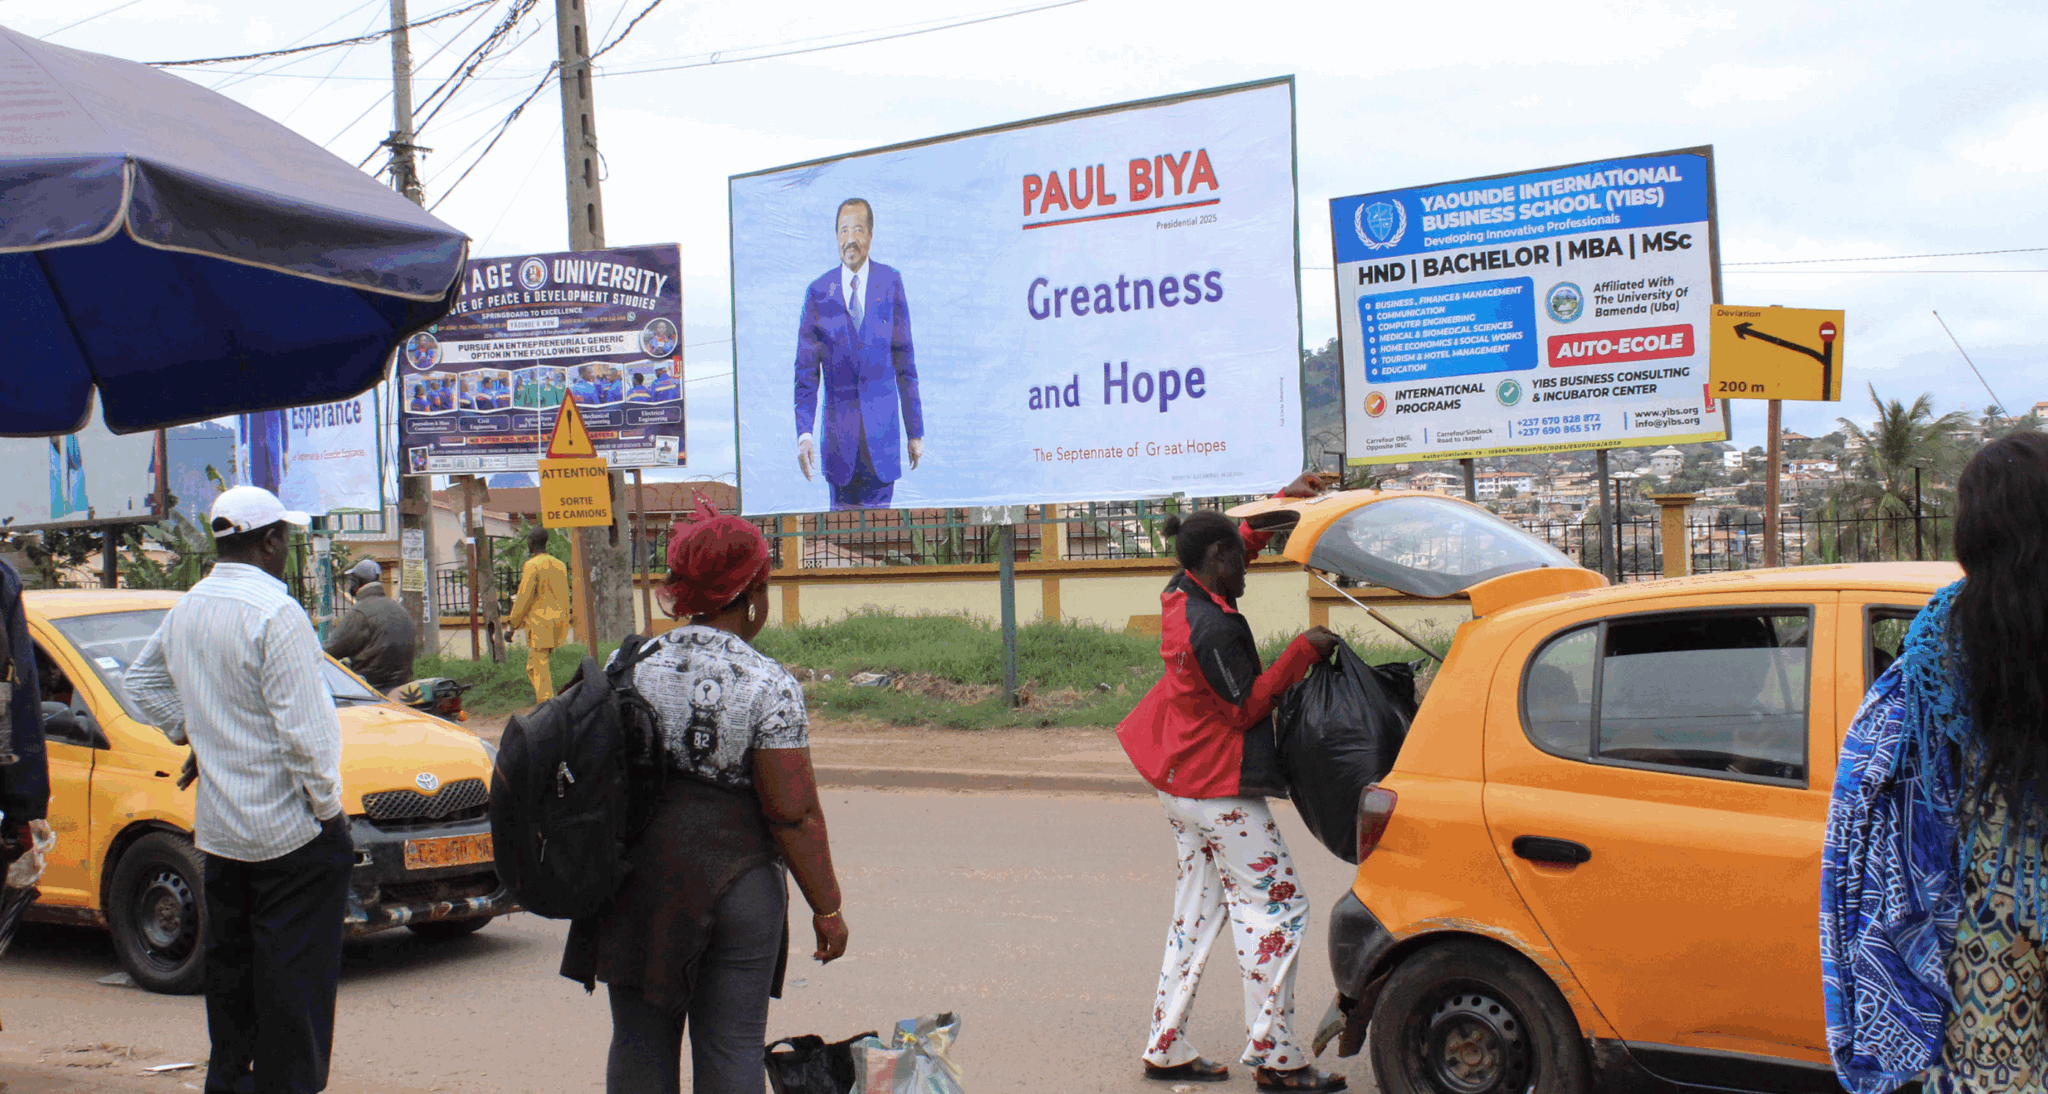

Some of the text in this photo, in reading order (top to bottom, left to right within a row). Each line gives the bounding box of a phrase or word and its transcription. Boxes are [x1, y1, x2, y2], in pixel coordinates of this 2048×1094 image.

[1022, 148, 1219, 217] PAUL BIYA
[1420, 165, 1682, 213] YAOUNDE INTERNATIONAL
[1422, 186, 1665, 232] BUSINESS SCHOOL (YIBS)
[1156, 214, 1218, 230] Presidential 2025
[1423, 212, 1621, 248] Developing Innovative Professionals
[1358, 262, 1406, 286] HND
[1423, 244, 1549, 277] BACHELOR
[1568, 235, 1624, 261] MBA
[1642, 230, 1693, 254] MSc
[461, 259, 668, 298] AGE UNIVERSITY
[1592, 275, 1674, 293] Affiliated With
[471, 298, 484, 311] OF
[487, 292, 520, 308] PEACE
[524, 292, 531, 303] &
[534, 289, 609, 303] DEVELOPMENT
[612, 293, 656, 311] STUDIES
[1027, 270, 1224, 321] Greatness
[1462, 285, 1523, 300] MANAGEMENT
[1594, 286, 1689, 306] The University Of
[481, 306, 583, 320] SPRINGBOARD TO EXCELLENCE
[1376, 306, 1446, 321] COMMUNICATION
[1595, 300, 1680, 318] Bamenda (Uba)
[1378, 313, 1476, 331] COMPUTER ENGINEERING
[1379, 331, 1413, 343] MEDICAL
[1422, 325, 1471, 338] BIOMEDICAL
[1473, 321, 1513, 333] SCIENCES
[458, 335, 625, 352] PURSUE AN ENTREPRENEURIAL GENERIC
[1380, 343, 1403, 354] HOME
[1404, 338, 1452, 351] ECONOMICS
[1459, 333, 1490, 345] SOCIAL
[1491, 331, 1523, 342] WORKS
[1556, 331, 1685, 360] AUTO-ECOLE
[470, 344, 612, 360] OPTION IN THE FOLLOWING FIELDS
[1381, 353, 1416, 365] TOURISM
[1424, 350, 1450, 361] HOTEL
[1452, 343, 1510, 358] MANAGEMENT
[1381, 363, 1427, 376] EDUCATION
[1532, 366, 1691, 390] YIBS BUSINESS CONSULTING
[1028, 361, 1206, 413] and Hope
[1395, 382, 1486, 401] INTERNATIONAL
[1532, 383, 1657, 403] & INCUBATOR CENTER
[1719, 381, 1765, 393] 200 m
[1395, 399, 1462, 415] PROGRAMS
[1634, 407, 1699, 419] www.yibs.org
[1517, 413, 1601, 428] +237 670 828 872
[1634, 417, 1701, 429] info@yibs.org
[1517, 427, 1540, 438] +237
[1542, 427, 1561, 437] 690
[1563, 424, 1582, 435] 865
[1365, 436, 1395, 445] Carrefour
[1365, 443, 1394, 452] Opposite
[1436, 436, 1453, 445] Road
[1454, 436, 1462, 444] to
[1033, 448, 1052, 462] The
[1056, 444, 1123, 464] Septennate
[1126, 442, 1140, 457] of
[1186, 438, 1227, 457] Hopes
[541, 466, 606, 479] ATTENTION
[560, 496, 593, 506] SORTIE
[547, 508, 607, 520] DE CAMIONS
[693, 731, 710, 748] 82
